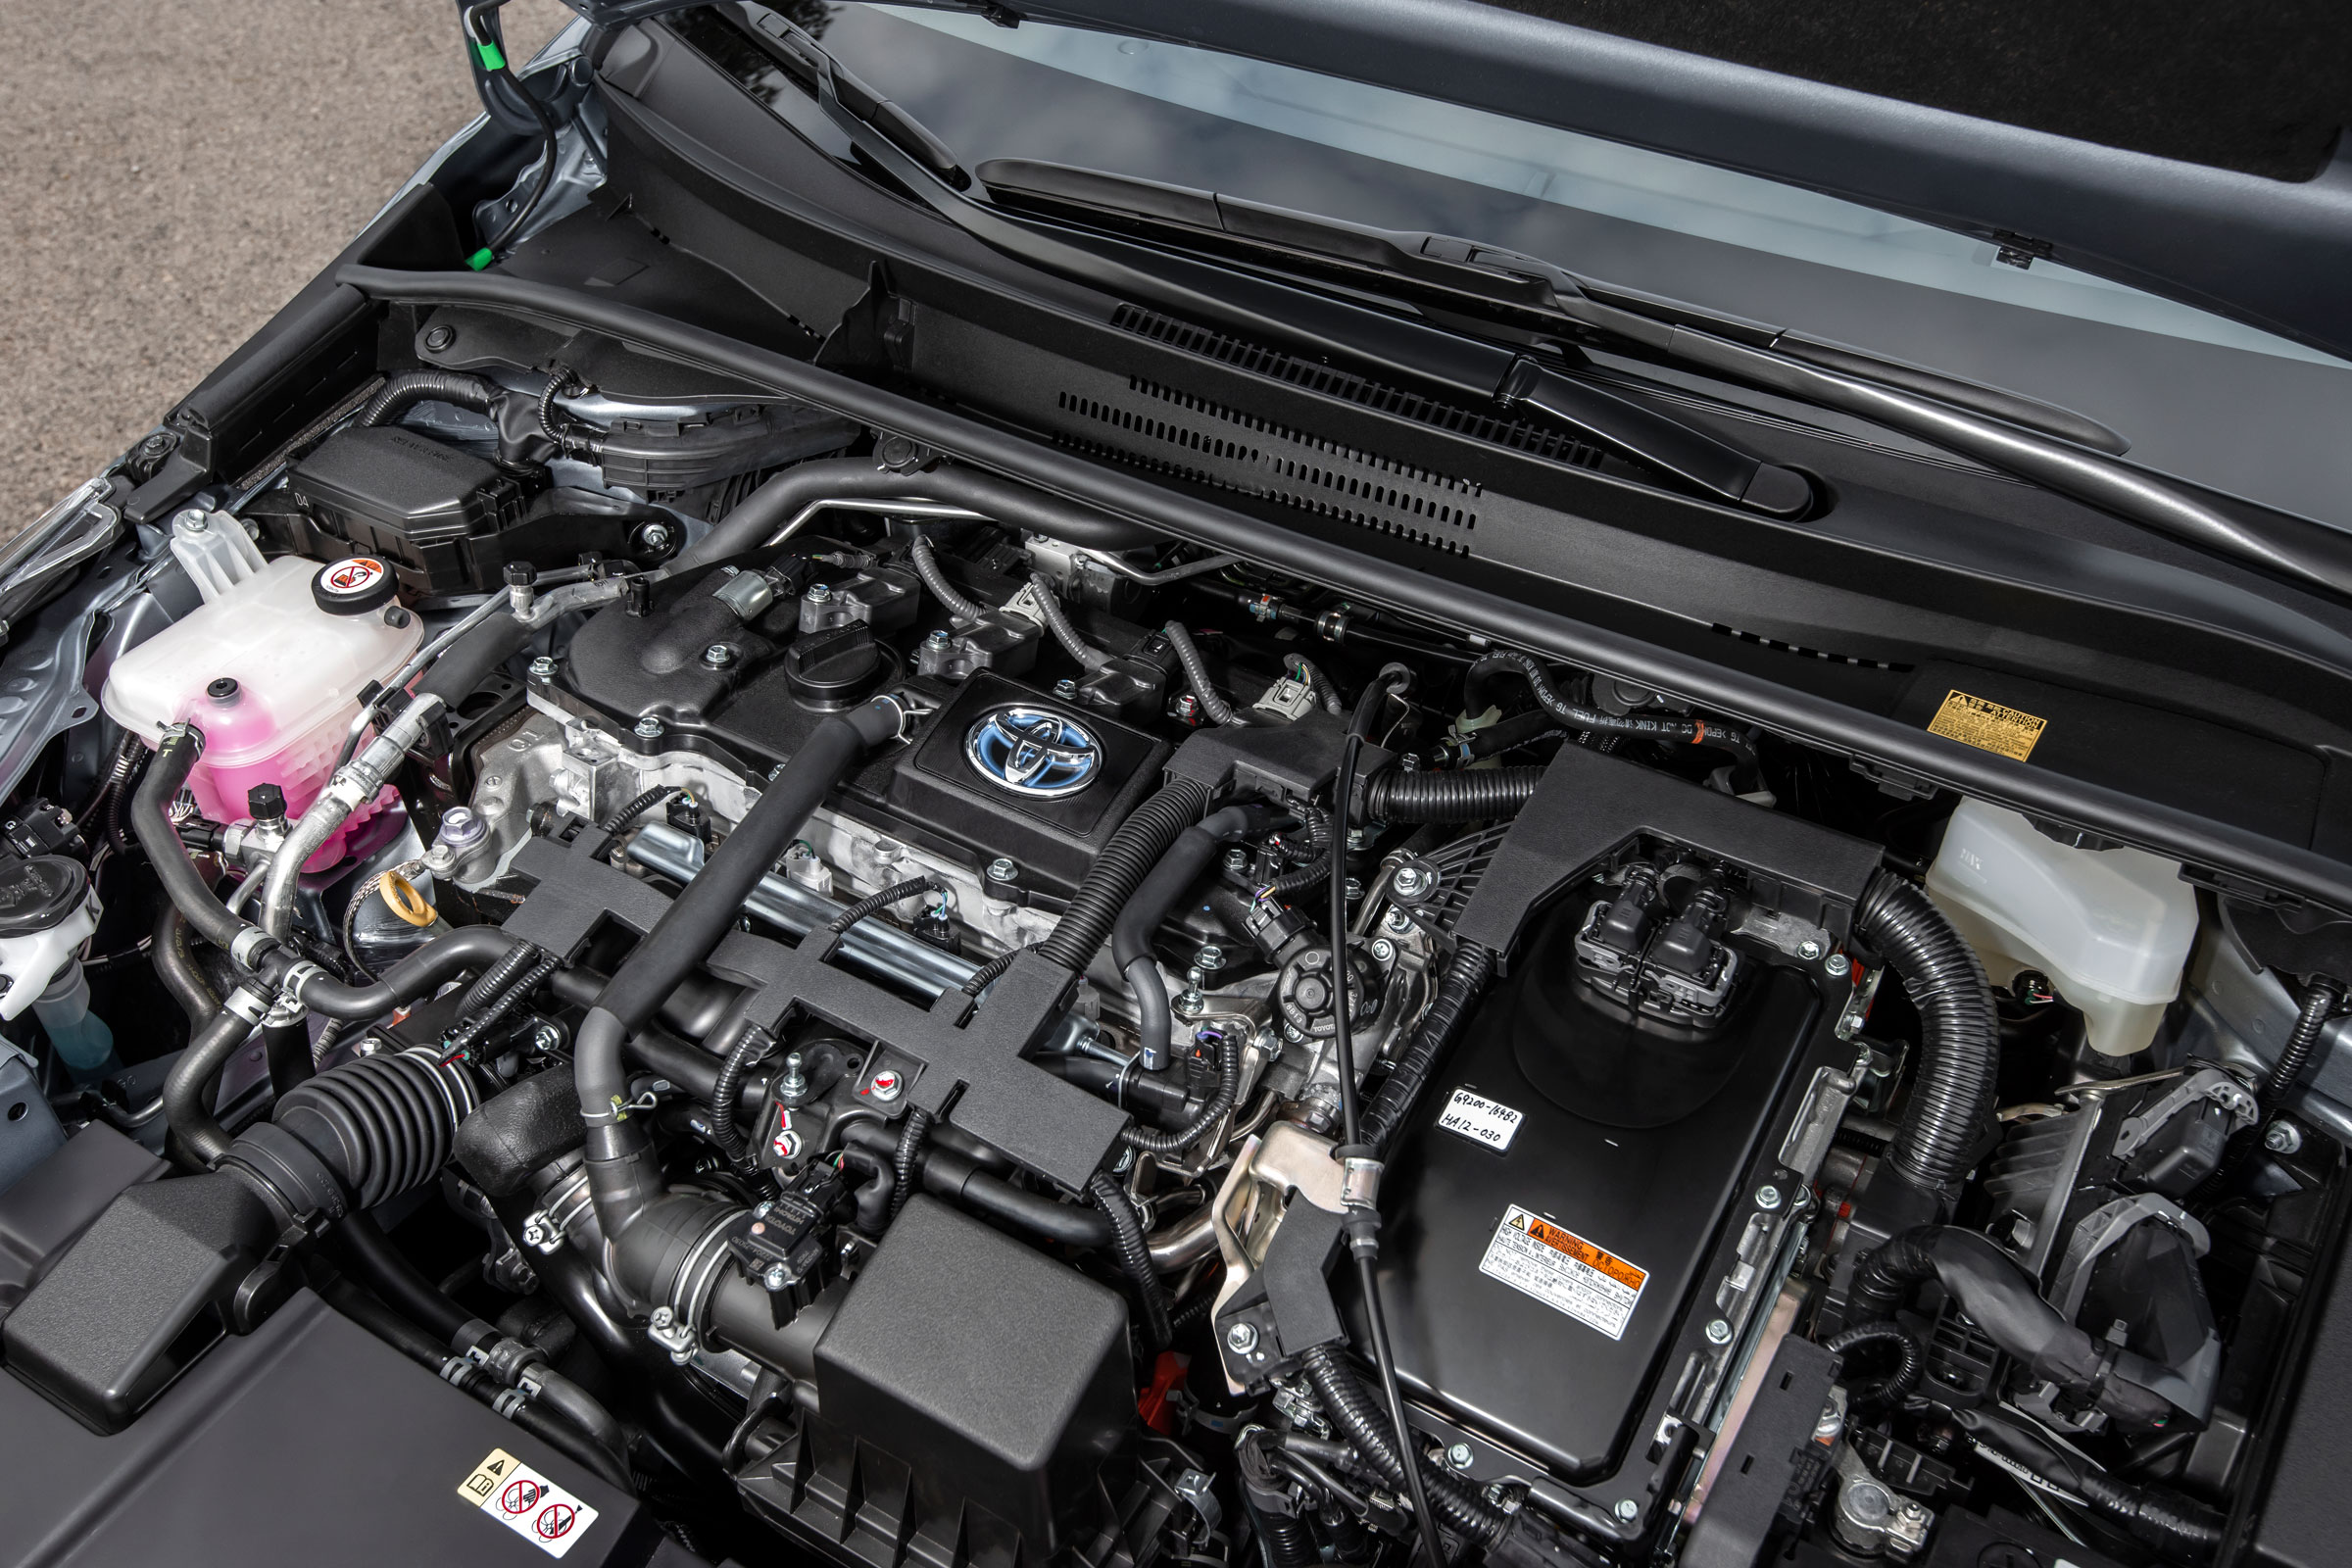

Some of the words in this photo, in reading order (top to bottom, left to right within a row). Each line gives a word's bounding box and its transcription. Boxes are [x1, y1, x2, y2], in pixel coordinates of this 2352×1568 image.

[1636, 719, 1656, 731] KINK
[1989, 710, 2037, 728] ATTENTION
[2002, 708, 2040, 724] CAUTION
[764, 1214, 796, 1235] TOYOTA
[774, 1207, 805, 1224] HITACHI
[1544, 1234, 1589, 1261] AVERTISSEMENT
[1547, 1227, 1584, 1250] WARNING
